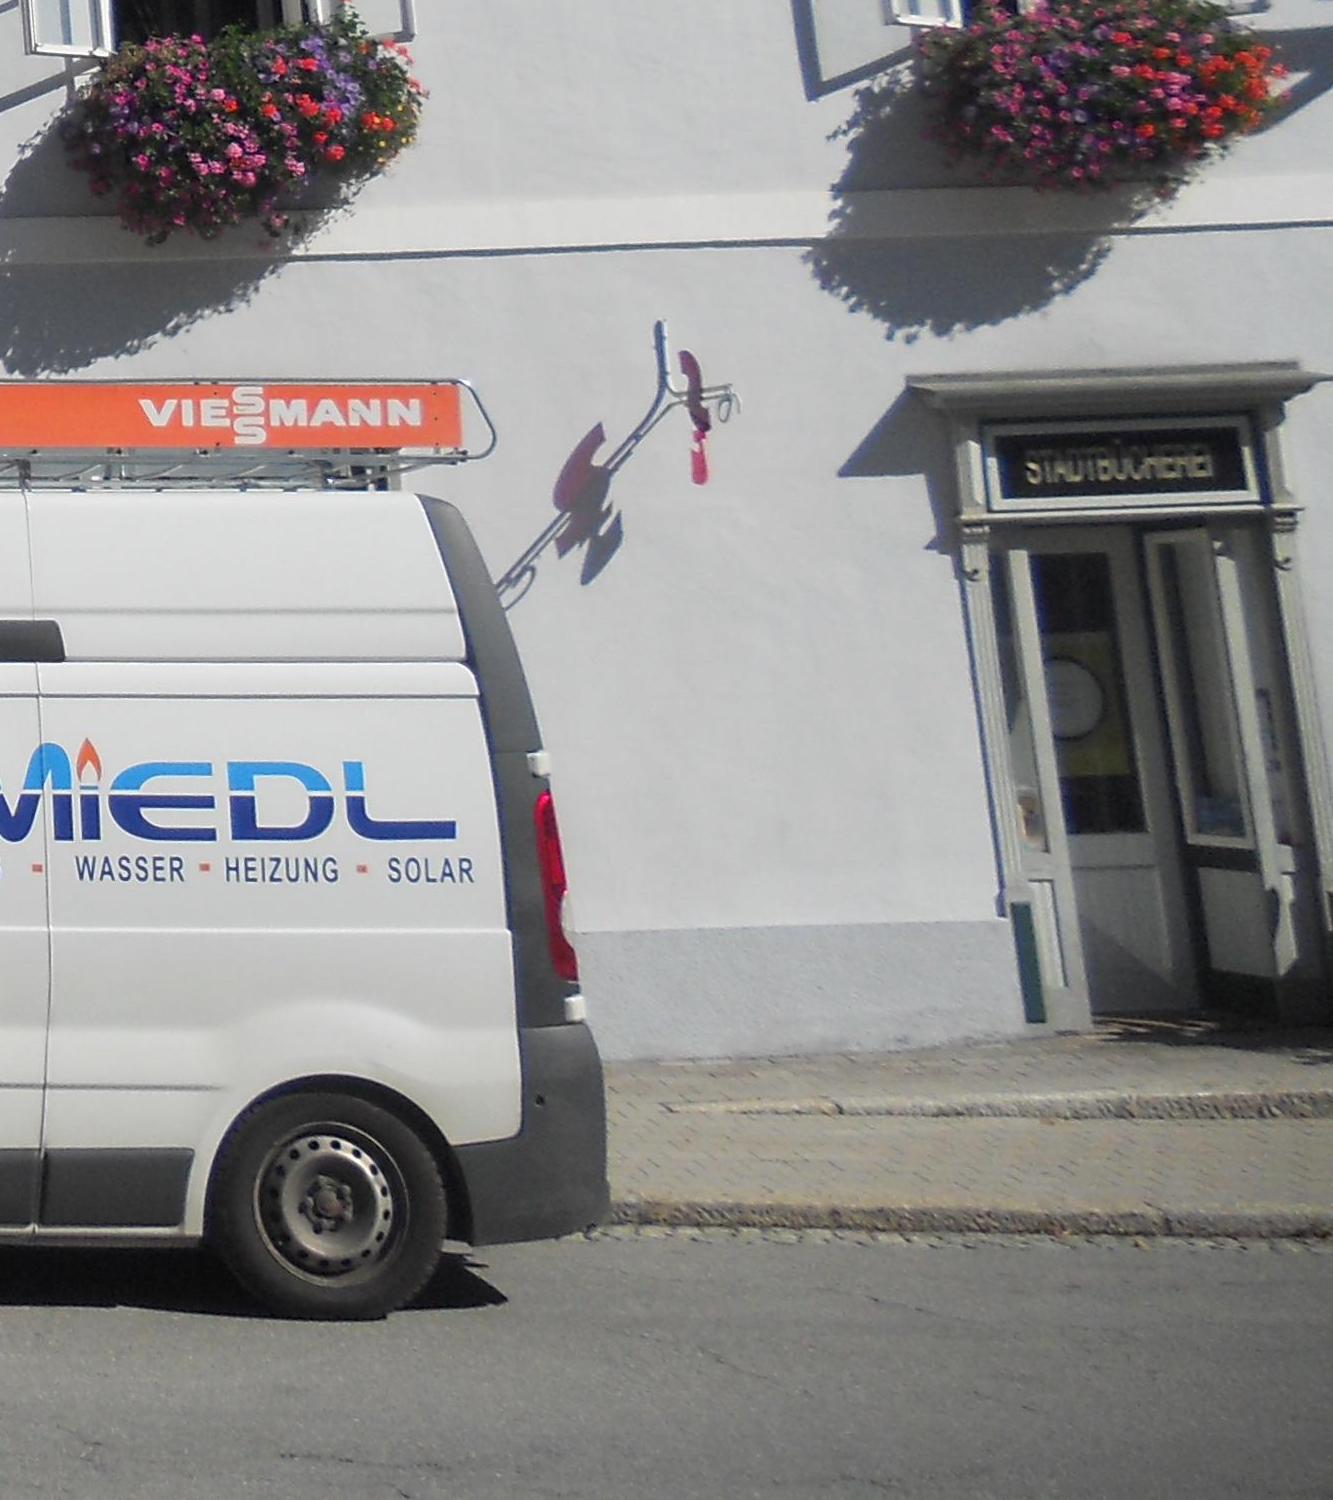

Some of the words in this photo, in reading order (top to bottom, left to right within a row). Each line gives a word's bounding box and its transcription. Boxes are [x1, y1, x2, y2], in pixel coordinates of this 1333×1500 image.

[137, 385, 423, 446] VIESSMANN
[75, 854, 186, 883] WASSER
[224, 857, 340, 885] HEIZUNG
[386, 857, 475, 885] SOLAR
